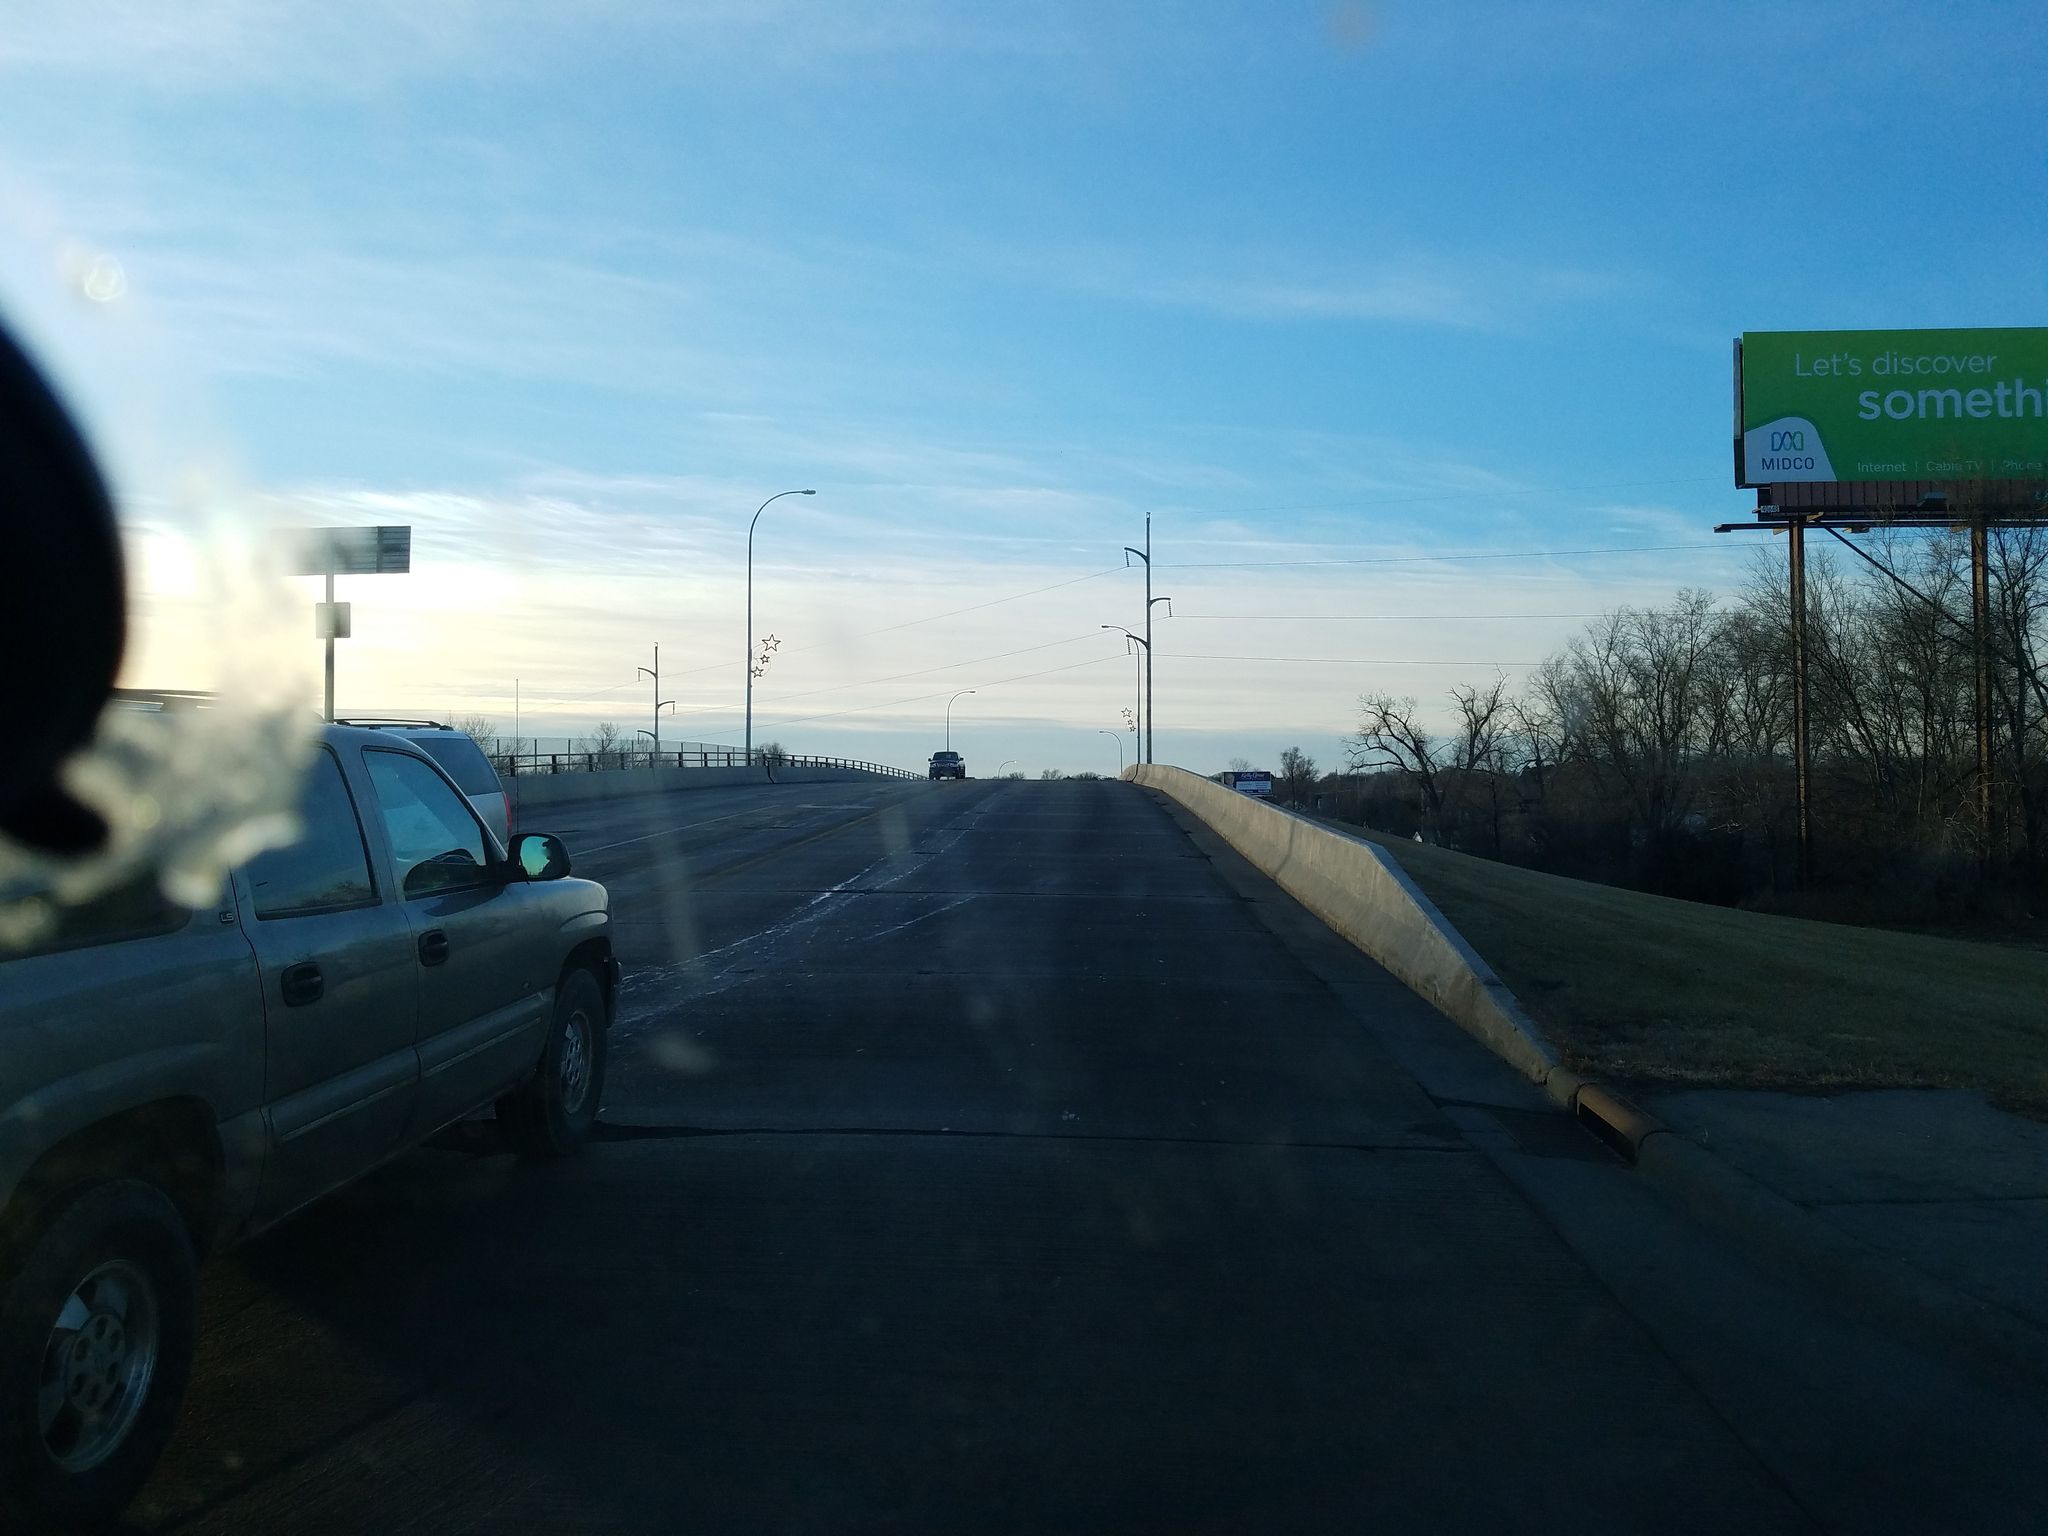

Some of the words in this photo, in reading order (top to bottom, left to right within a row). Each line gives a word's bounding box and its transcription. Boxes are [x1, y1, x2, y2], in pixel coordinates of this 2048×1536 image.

[1795, 352, 1863, 377] Let's
[1872, 350, 1998, 376] discover
[1857, 377, 2048, 420] someth
[1761, 457, 1815, 471] MIDCO
[1857, 461, 1907, 473] Internet
[220, 913, 234, 922] LS
